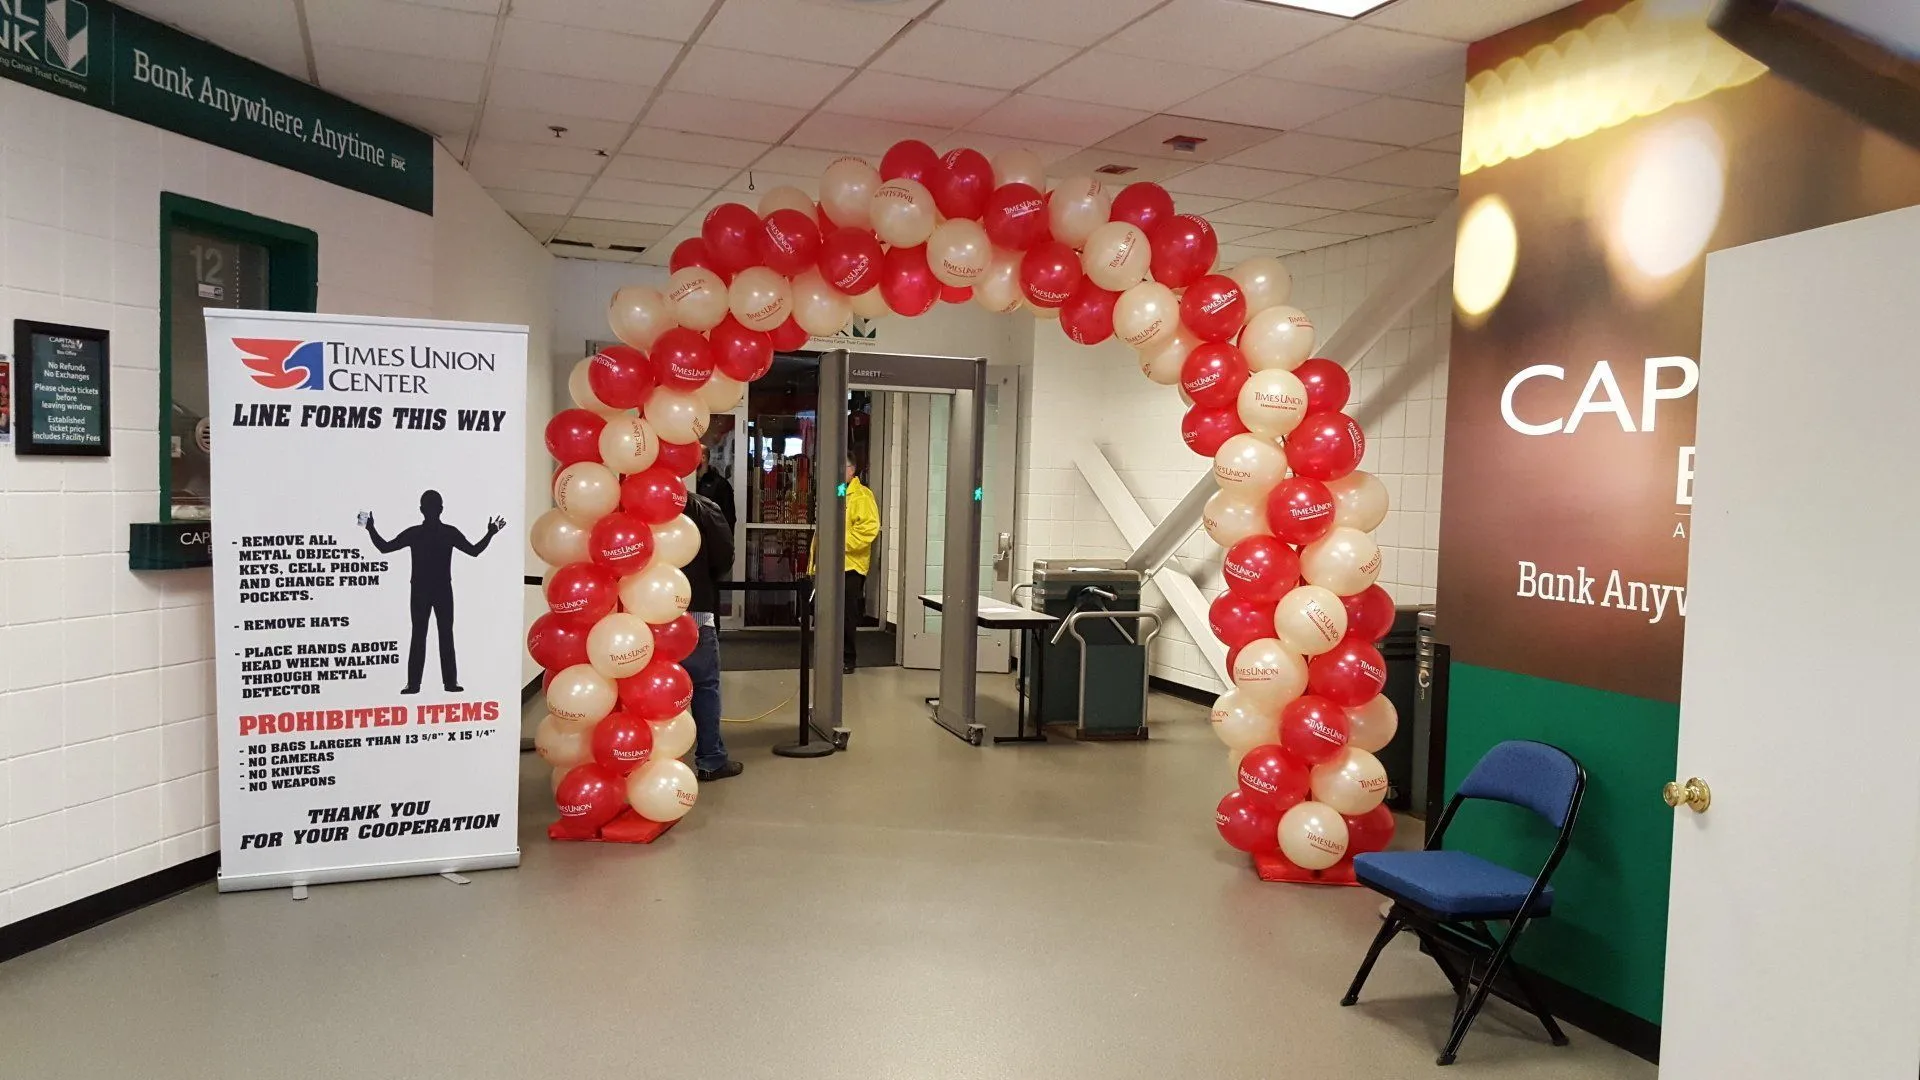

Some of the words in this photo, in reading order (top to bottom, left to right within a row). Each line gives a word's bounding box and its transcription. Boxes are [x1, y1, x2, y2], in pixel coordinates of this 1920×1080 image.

[133, 48, 195, 100] Bank
[198, 76, 308, 142] Anywhere,
[312, 118, 385, 167] Anytime
[190, 244, 224, 284] 12
[327, 342, 405, 367] TIMES
[411, 345, 496, 372] UNION
[48, 361, 58, 369] No
[59, 362, 86, 372] Refunds
[852, 369, 882, 378] GARRETT
[44, 370, 55, 378] No
[55, 371, 90, 382] Exchanges
[328, 369, 430, 395] CENTER
[34, 383, 57, 392] Please
[57, 385, 76, 394] check
[77, 386, 99, 395] tickets
[55, 393, 78, 402] before
[41, 401, 66, 411] leaving
[67, 402, 92, 411] window
[48, 415, 86, 425] Established
[232, 403, 292, 427] LINE
[300, 405, 383, 430] FORMS
[393, 407, 448, 431] THIS
[457, 409, 507, 432] WAY
[49, 424, 68, 432] ticket
[69, 425, 86, 434] price
[32, 431, 61, 440] includes
[61, 433, 85, 443] Facility
[86, 434, 101, 442] Fees
[242, 535, 305, 548] REMOVE
[309, 534, 338, 547] ALL
[239, 549, 292, 562] METAL
[296, 548, 366, 561] OBJECTS,
[239, 563, 285, 577] KEYS,
[288, 562, 327, 574] CELL
[330, 561, 389, 573] PHONES
[239, 577, 272, 590] AND
[275, 576, 336, 589] CHANGE
[339, 575, 380, 587] FROM
[1517, 560, 1595, 605] Bank
[240, 590, 315, 604] POCKETS.
[244, 617, 306, 631] REMOVE
[310, 616, 350, 628] HATS
[244, 644, 293, 658] PLACE
[297, 642, 348, 655] HANDS
[351, 640, 399, 653] ABOVE
[241, 659, 282, 672] HEAD
[286, 657, 329, 669] WHEN
[334, 653, 400, 667] WALKING
[241, 671, 313, 686] THROUGH
[317, 669, 367, 681] METAL
[242, 684, 322, 699] DETECTOR
[239, 705, 408, 736] PROHIBITED
[416, 701, 500, 725] ITEMS
[248, 744, 267, 756] NO
[271, 741, 307, 754] BAGS
[310, 737, 363, 751] LARGER
[365, 735, 401, 747] THAN
[405, 734, 419, 745] 13
[447, 731, 457, 742] X
[459, 730, 473, 741] 15
[248, 756, 267, 768] NO
[271, 752, 335, 766] CAMERAS
[248, 768, 267, 780] NO
[271, 765, 321, 778] KNIVES
[249, 780, 267, 792] NO
[271, 776, 337, 790] WEAPONS
[308, 804, 381, 824] THANK
[390, 800, 431, 817] YOU
[240, 832, 284, 850] FOR
[293, 825, 349, 845] YOUR
[358, 813, 501, 840] COOPERATION
